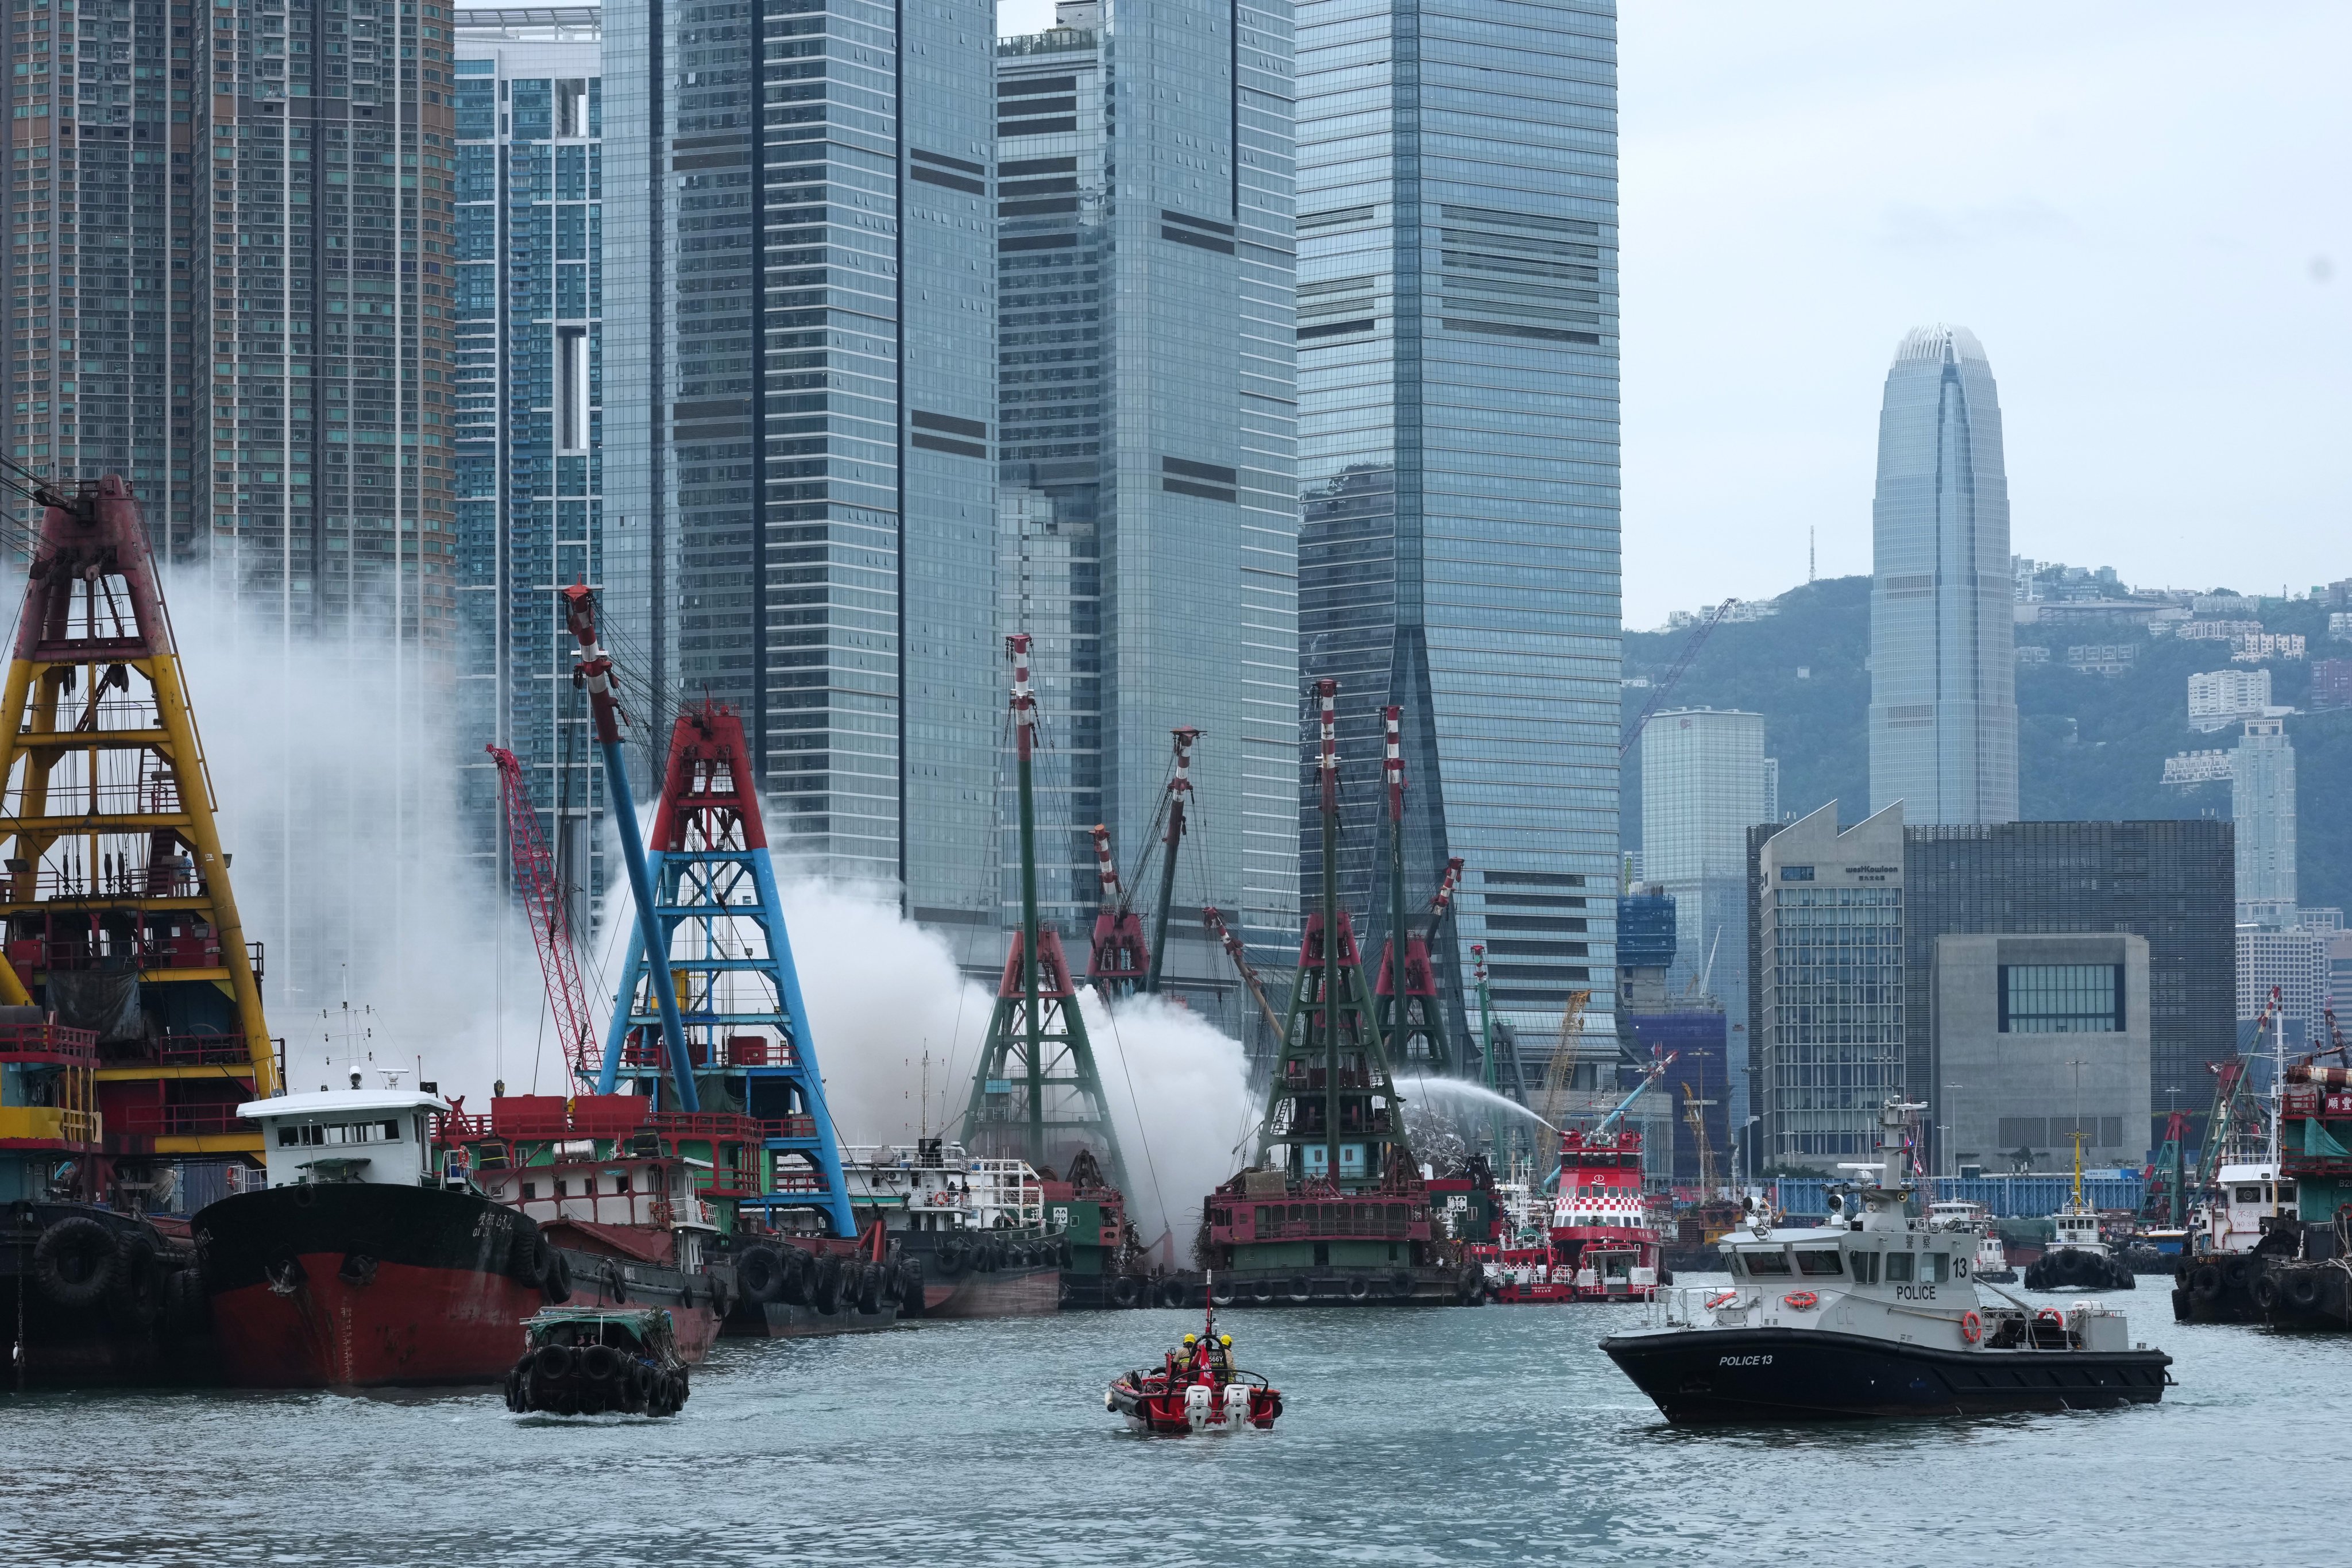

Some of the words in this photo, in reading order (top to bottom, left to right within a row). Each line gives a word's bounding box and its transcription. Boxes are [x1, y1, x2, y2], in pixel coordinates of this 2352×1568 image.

[2328, 1096, 2352, 1110] 順豐
[1906, 1234, 1930, 1249] 警察
[1953, 1257, 1967, 1278] 13
[1897, 1286, 1936, 1300] POLICE
[1719, 1356, 1760, 1366] POLICE
[1762, 1355, 1773, 1365] 13
